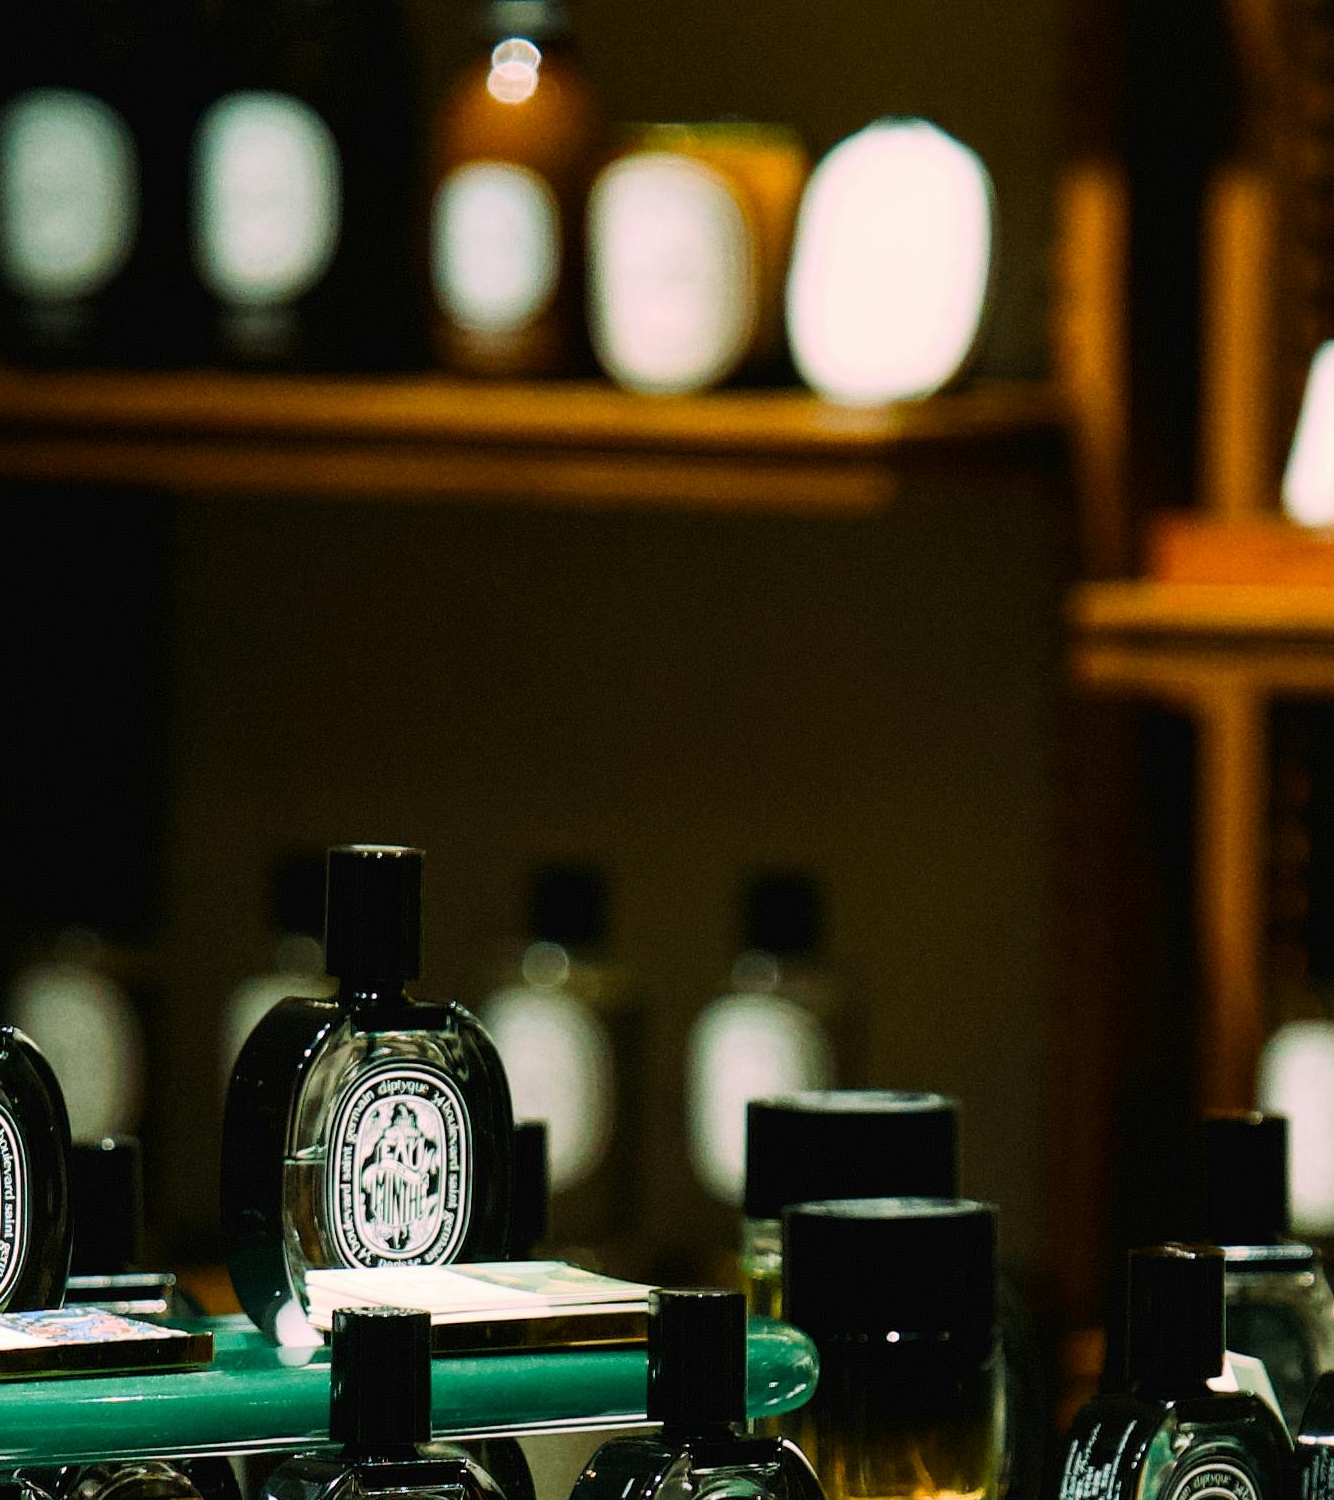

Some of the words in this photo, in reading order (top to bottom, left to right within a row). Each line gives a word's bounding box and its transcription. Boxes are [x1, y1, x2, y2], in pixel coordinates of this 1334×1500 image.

[377, 1080, 430, 1096] diptyque
[345, 1090, 375, 1144] germain
[341, 1146, 353, 1182] saint
[448, 1173, 459, 1209] saint
[4, 1204, 15, 1238] saint
[424, 1210, 456, 1263] germain
